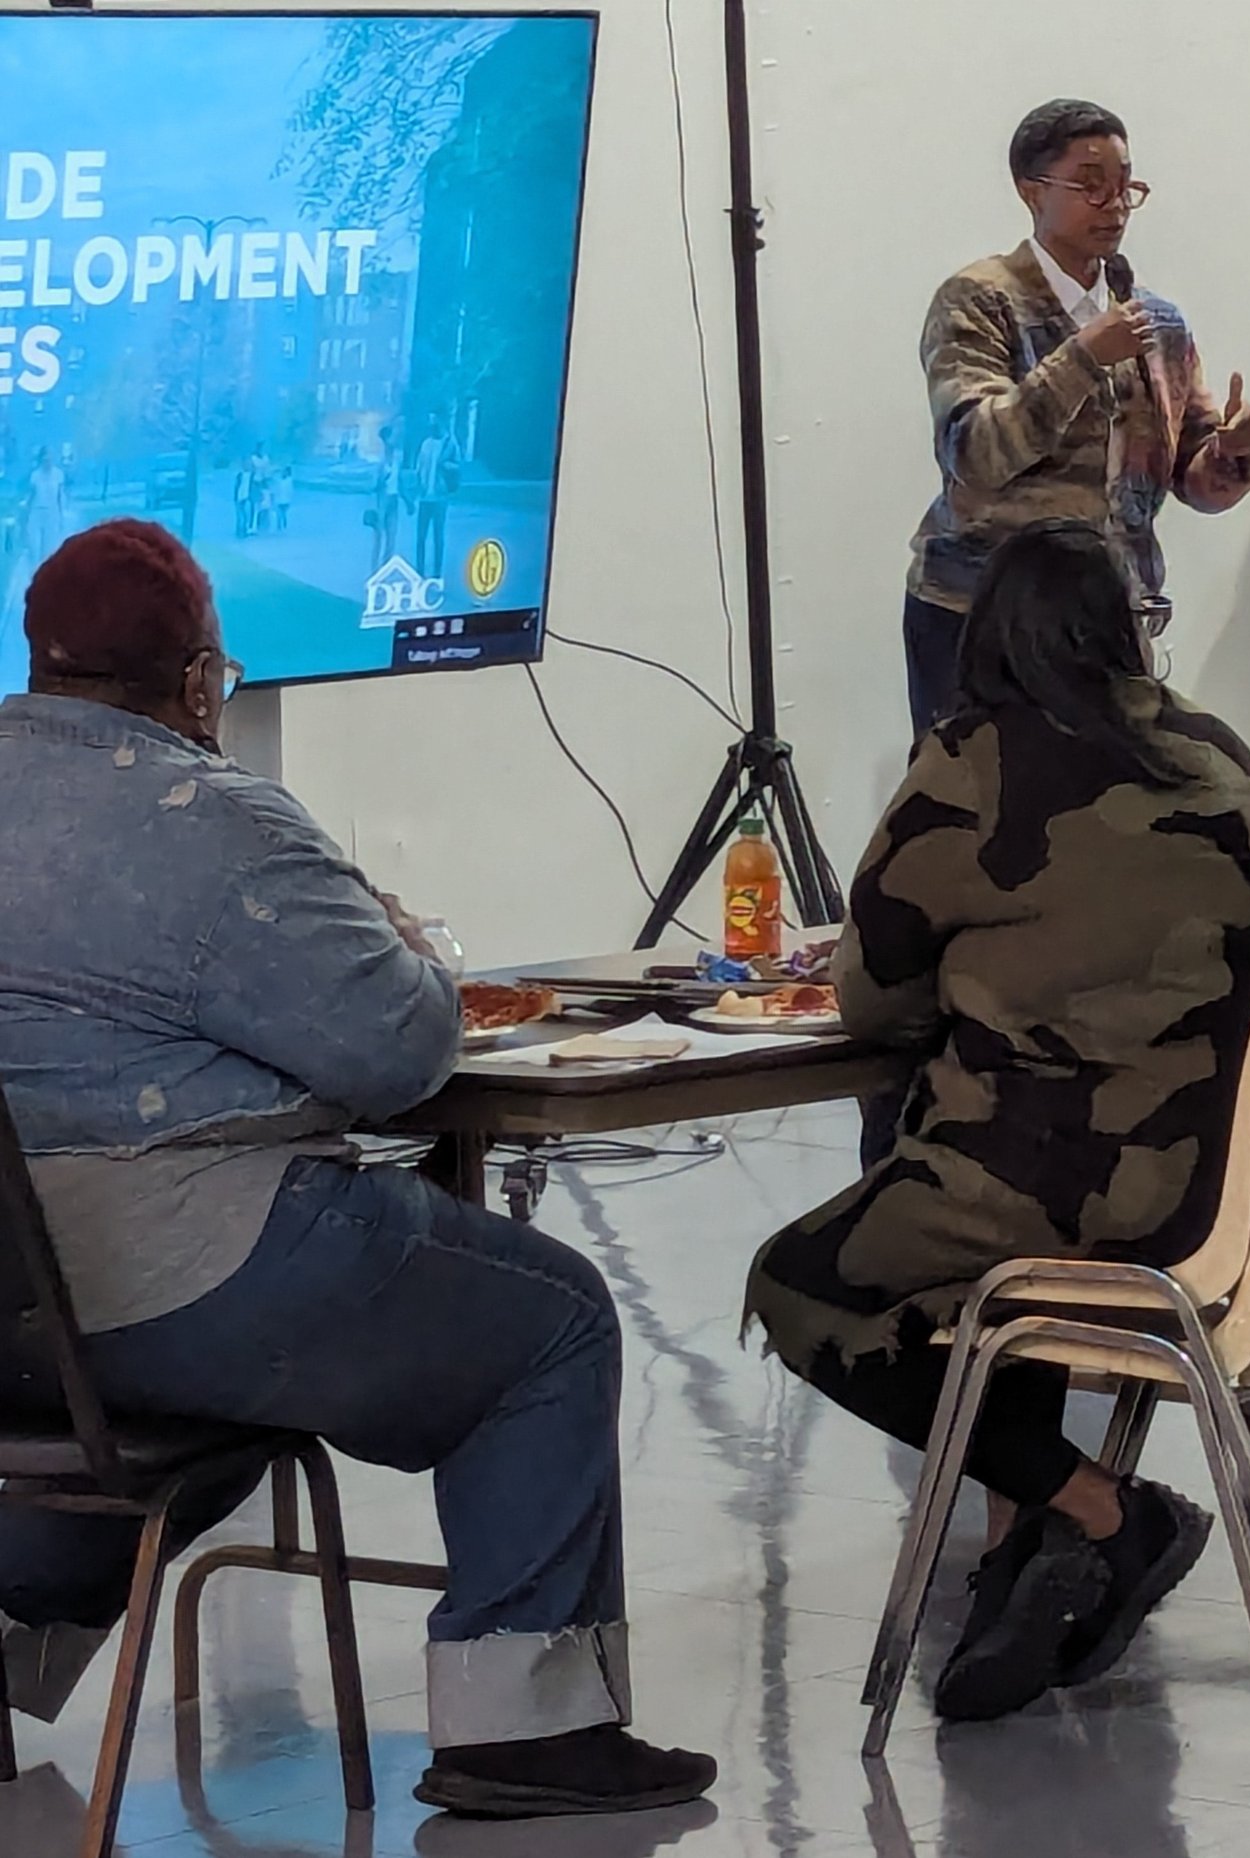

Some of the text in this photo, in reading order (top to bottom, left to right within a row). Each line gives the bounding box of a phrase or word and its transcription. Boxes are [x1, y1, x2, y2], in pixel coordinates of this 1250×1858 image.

[6, 150, 107, 220] DE
[0, 229, 378, 308] ELOPMENT
[366, 577, 445, 616] DHC
